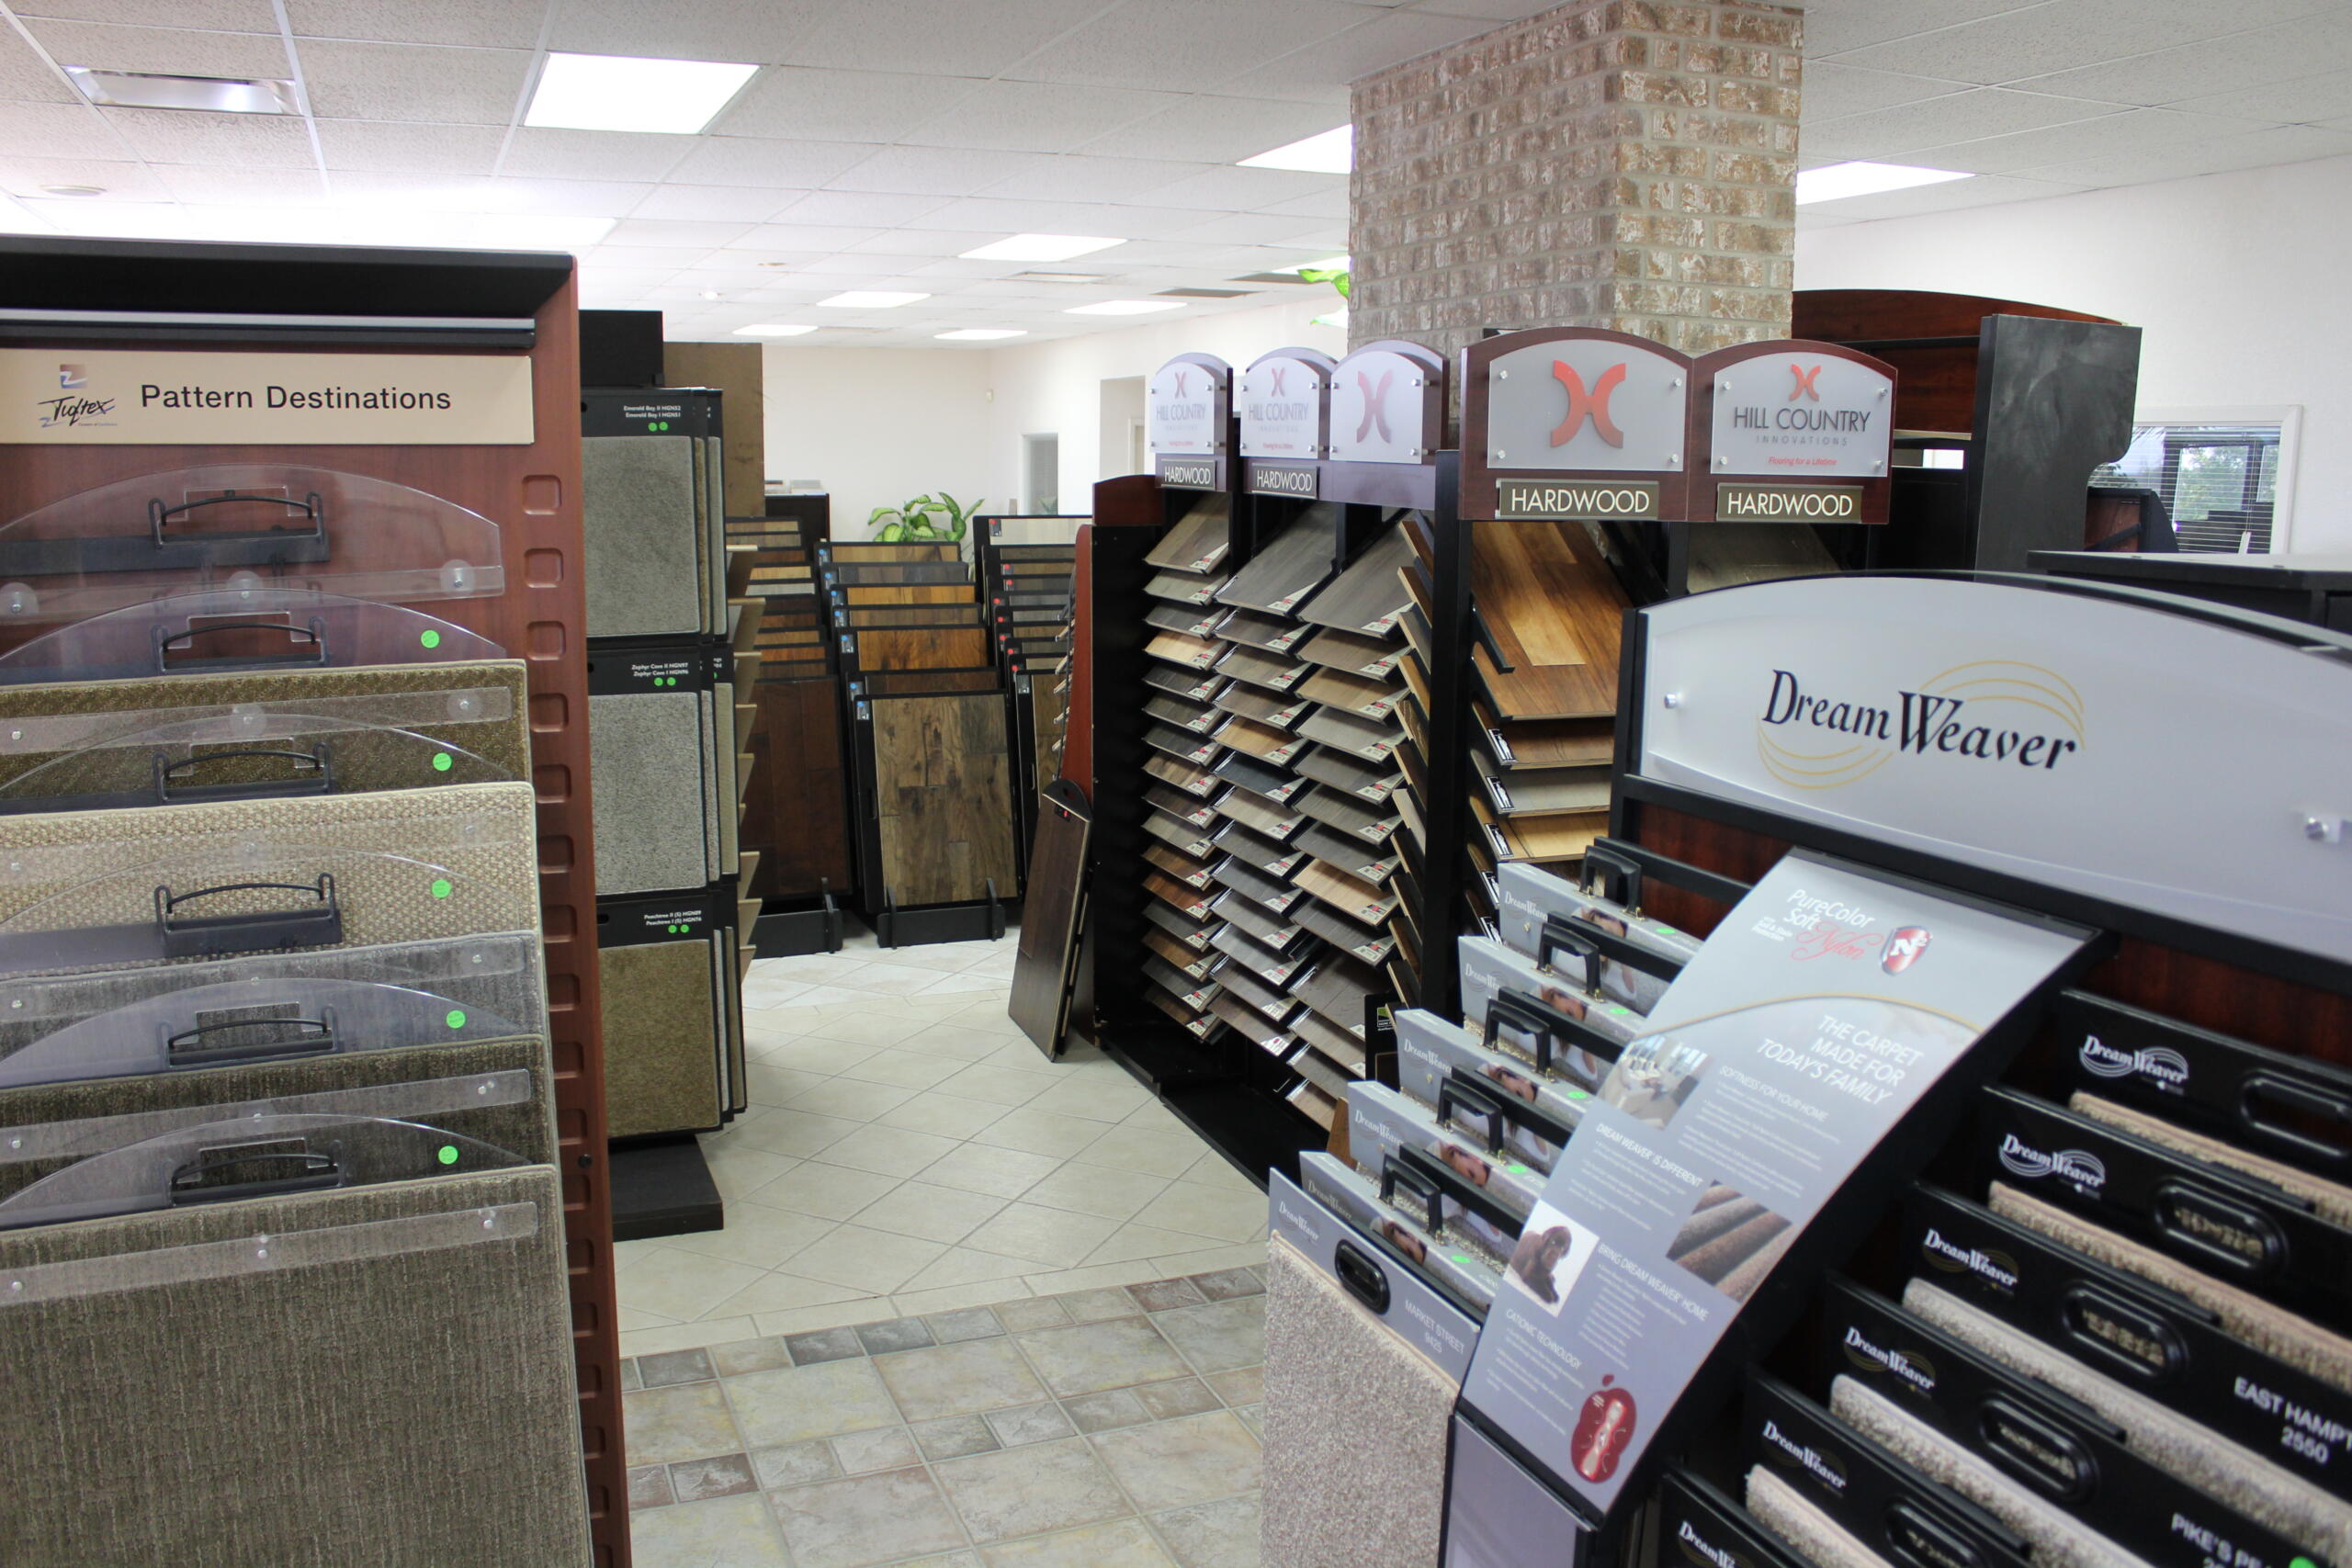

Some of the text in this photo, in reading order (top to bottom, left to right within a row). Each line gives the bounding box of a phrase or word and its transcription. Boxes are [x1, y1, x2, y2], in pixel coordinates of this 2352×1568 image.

[141, 384, 451, 410] Pattern Destinations
[1266, 403, 1309, 421] COUNTRY
[1734, 407, 1852, 432] HILL COUNTRY
[1756, 435, 1848, 446] INNOVATIONS
[1164, 466, 1211, 484] HARDWOOD
[1257, 469, 1313, 491] HARDWOOD
[1511, 488, 1650, 513] HARDWOOD
[1727, 492, 1853, 516] HARDWOOD
[1787, 889, 1876, 928] PureColor
[1818, 1014, 1925, 1066] THE CARPET
[1757, 1038, 1893, 1105] TODAY'S FAMILY
[1810, 1037, 1906, 1087] MADE FOR
[2234, 1376, 2283, 1413] EAST
